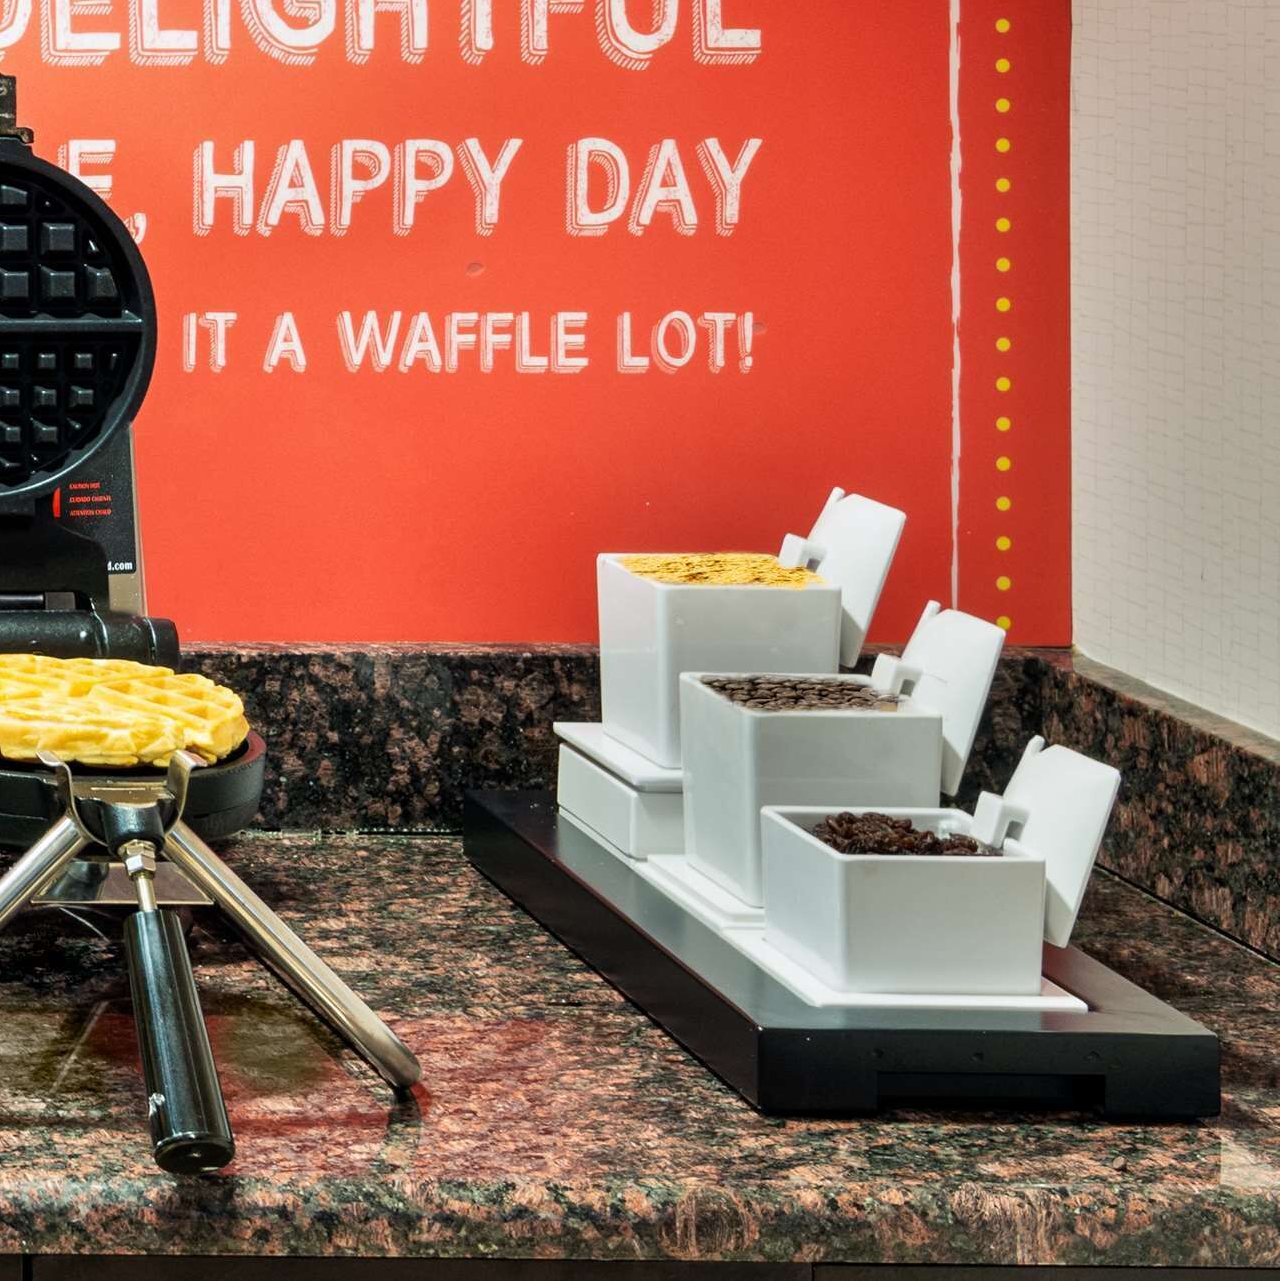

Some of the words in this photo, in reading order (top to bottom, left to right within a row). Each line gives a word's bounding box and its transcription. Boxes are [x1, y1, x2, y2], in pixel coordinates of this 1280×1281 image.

[192, 137, 523, 238] HAPPY
[565, 136, 763, 237] DAY
[183, 311, 238, 374] IT
[263, 311, 307, 374] A
[337, 310, 589, 374] WAFFLE
[616, 310, 755, 374] LOT!
